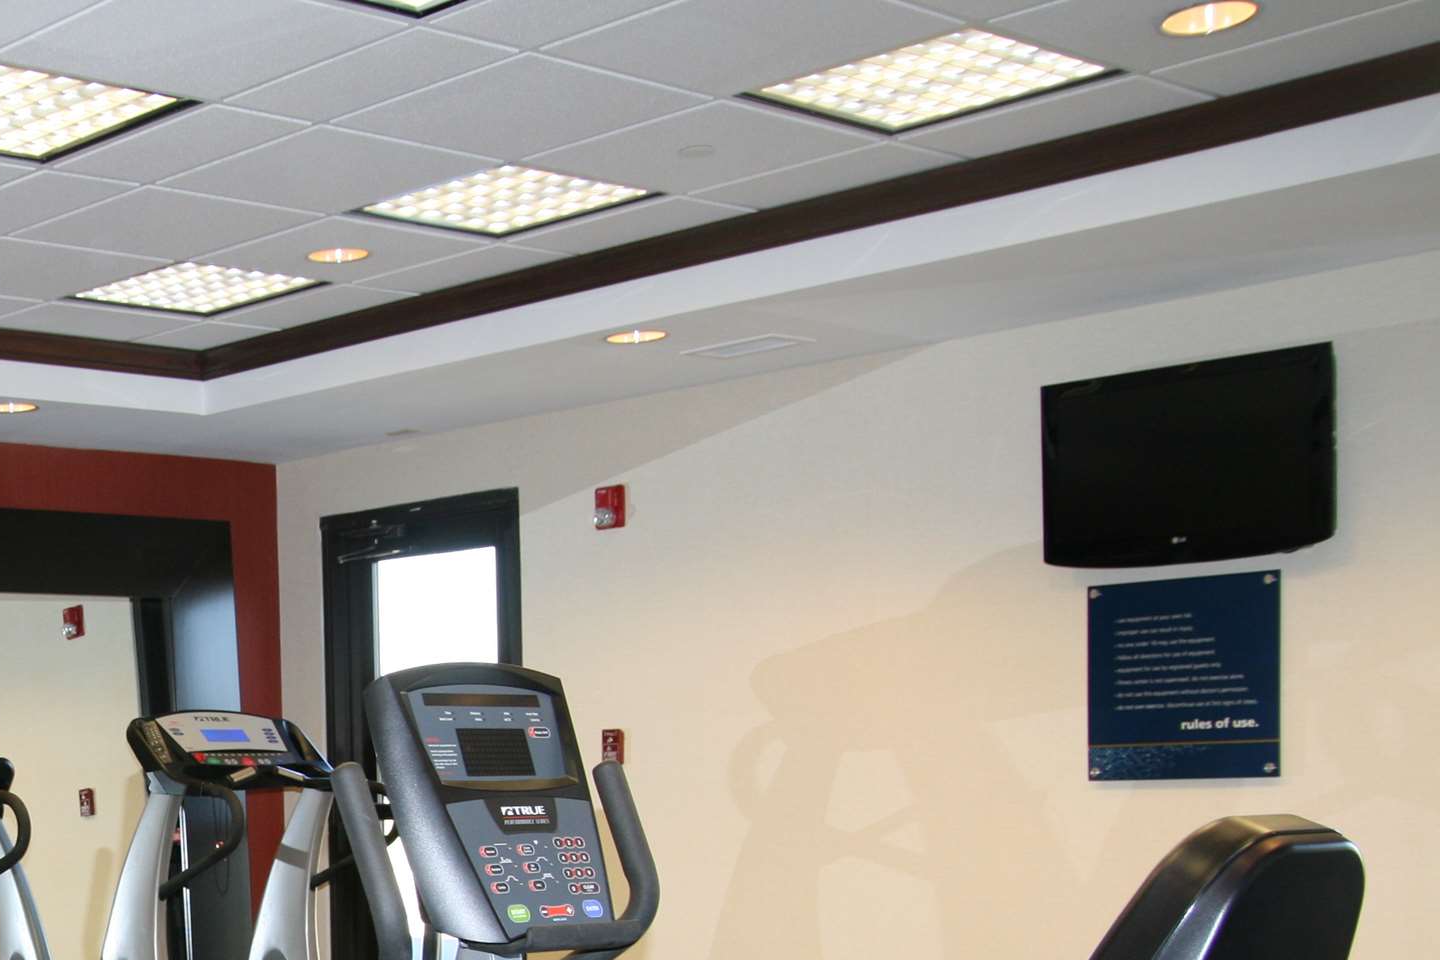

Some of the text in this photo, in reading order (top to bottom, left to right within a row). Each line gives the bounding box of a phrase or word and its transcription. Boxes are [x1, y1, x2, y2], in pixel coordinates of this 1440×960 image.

[1181, 716, 1259, 730] rules of use.
[512, 805, 546, 815] TRUE
